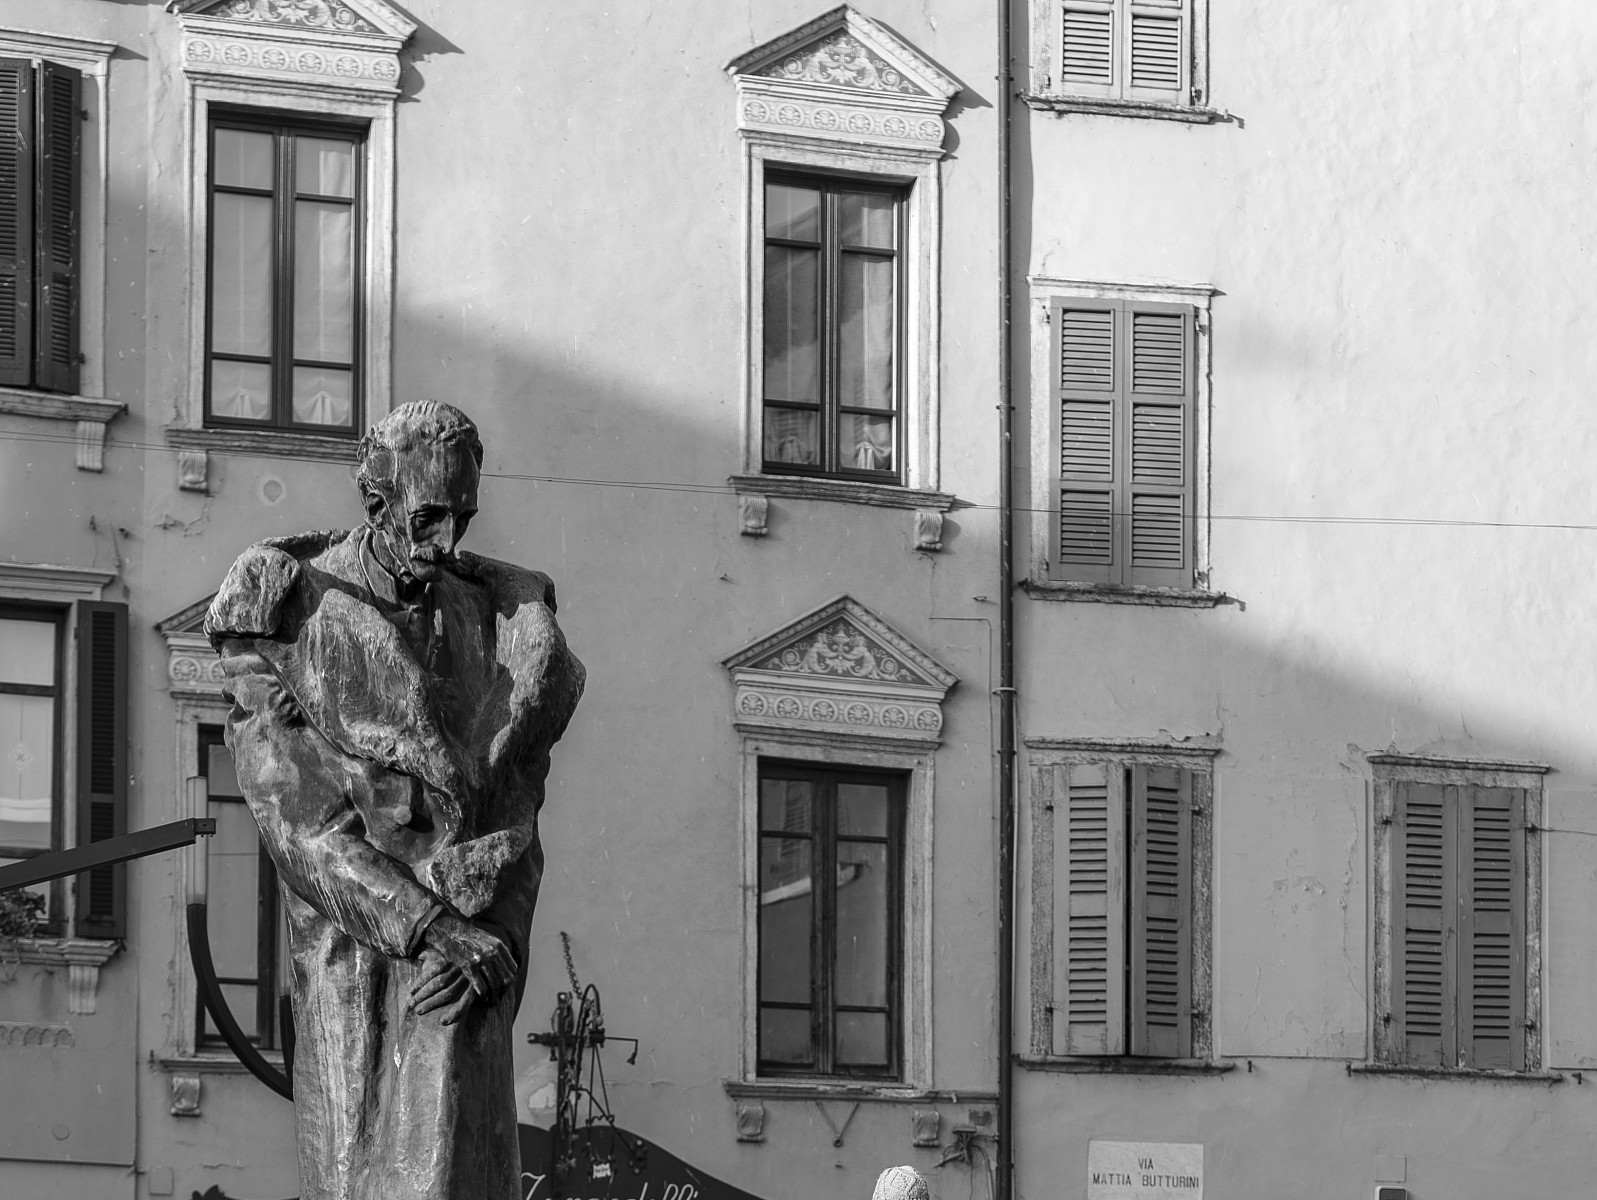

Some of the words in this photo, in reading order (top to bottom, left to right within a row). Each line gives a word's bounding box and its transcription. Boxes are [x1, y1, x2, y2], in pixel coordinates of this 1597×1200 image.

[1138, 1158, 1154, 1171] VIA
[1092, 1173, 1132, 1187] MATTIA
[1142, 1175, 1199, 1189] BUTTURINI
